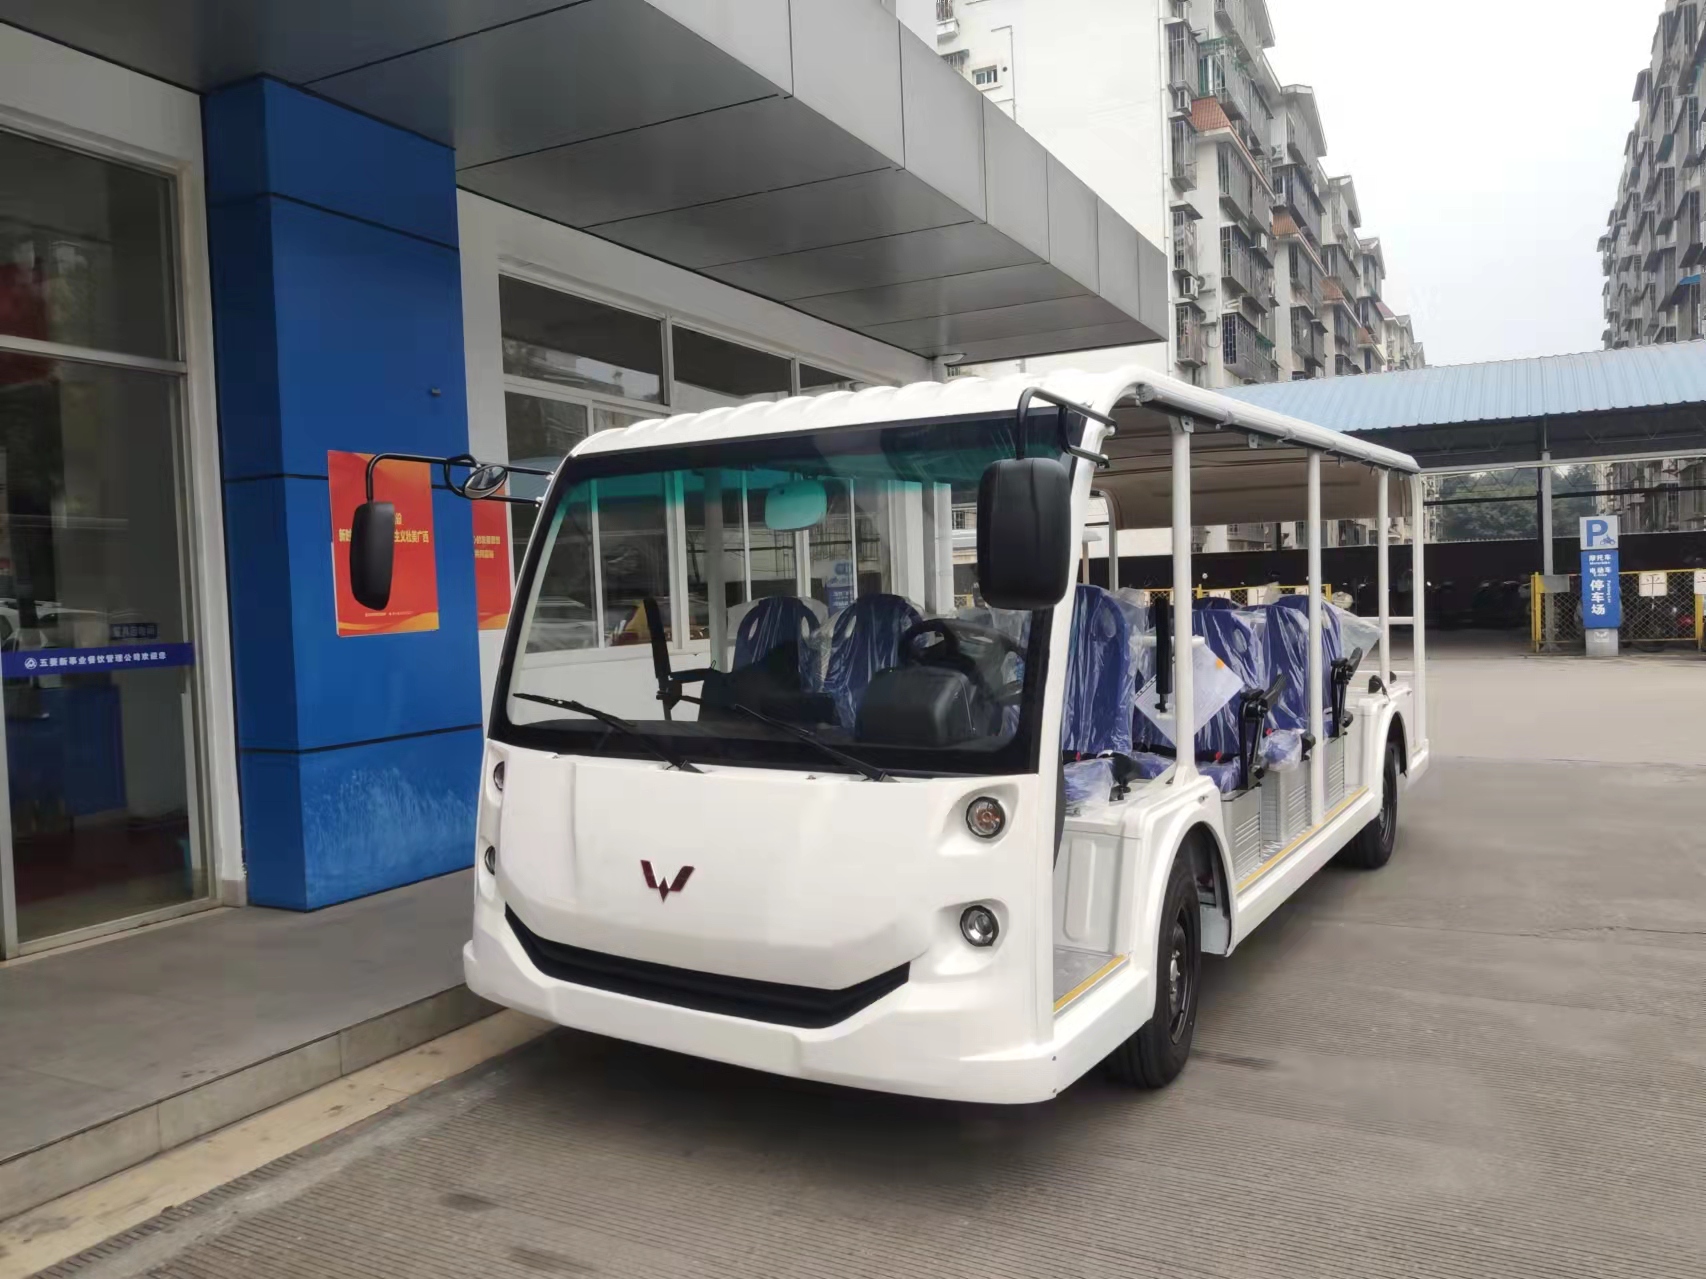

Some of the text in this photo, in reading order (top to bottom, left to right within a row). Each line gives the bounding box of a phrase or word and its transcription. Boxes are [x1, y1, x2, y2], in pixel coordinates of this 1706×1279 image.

[1586, 519, 1608, 547] P
[1590, 579, 1605, 615] 停车场
